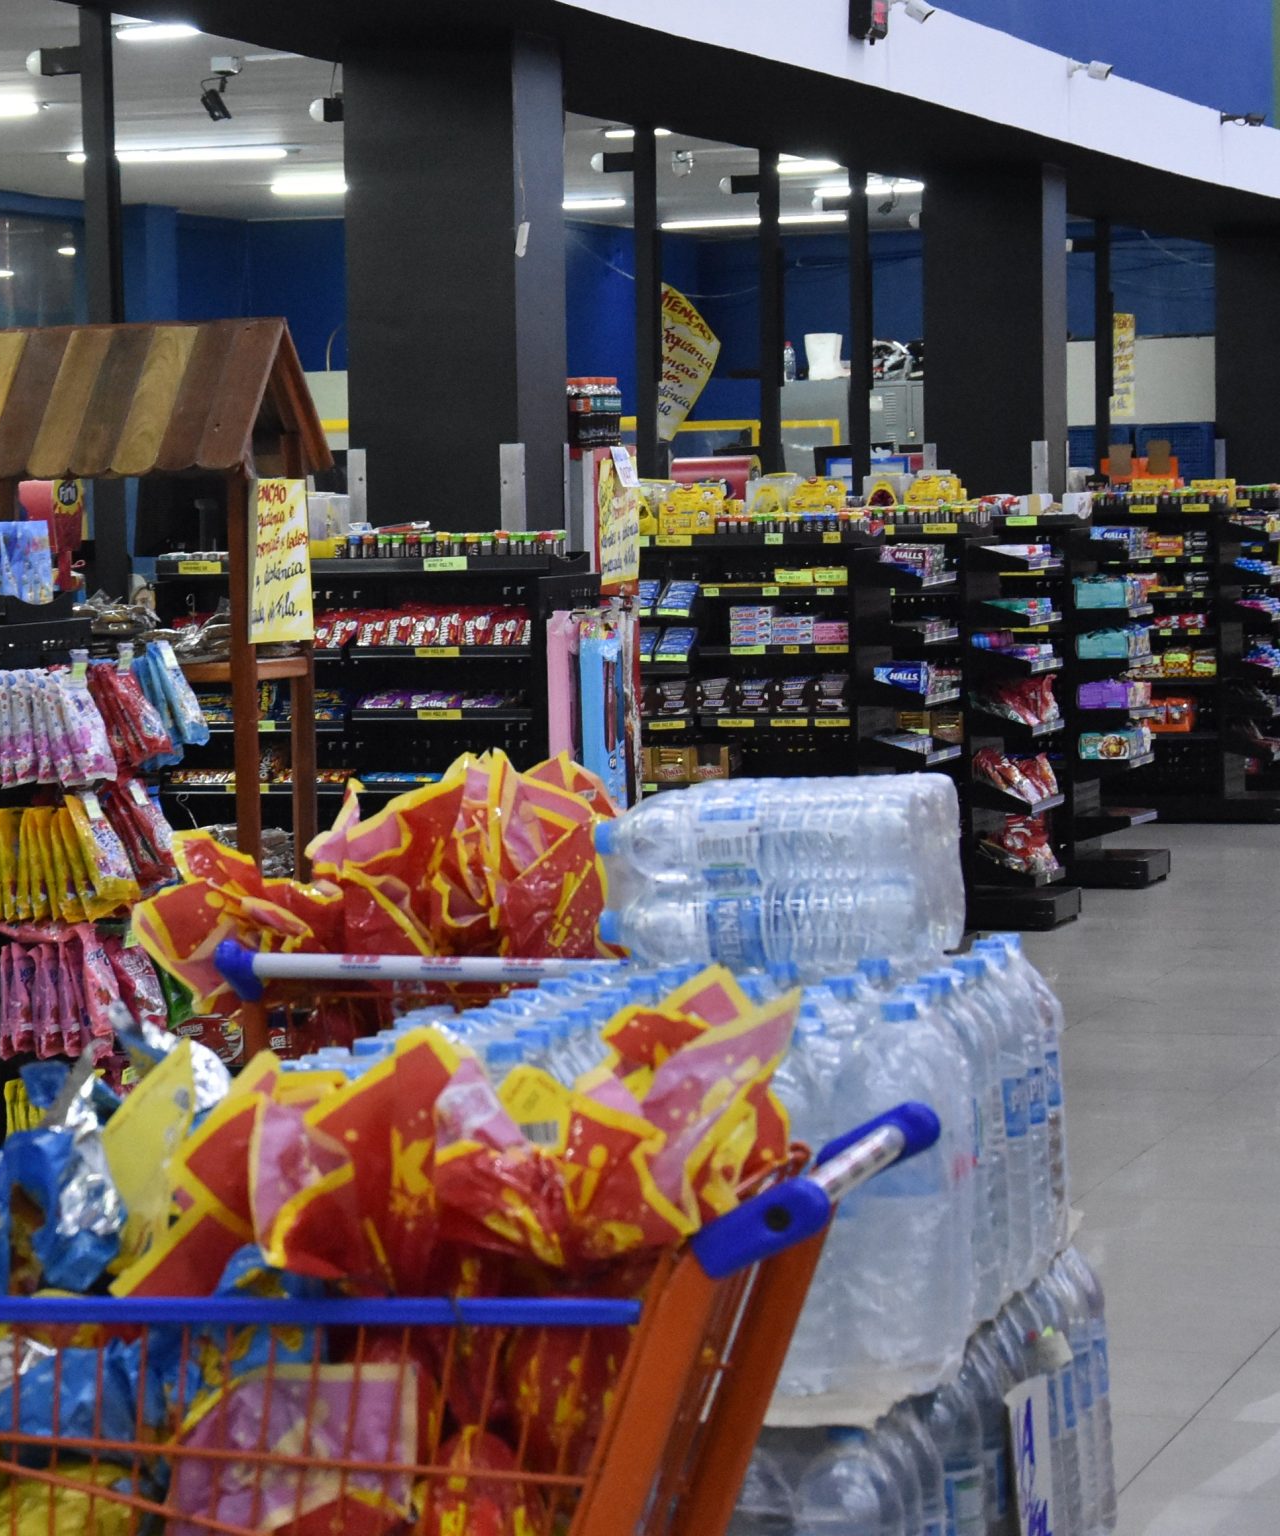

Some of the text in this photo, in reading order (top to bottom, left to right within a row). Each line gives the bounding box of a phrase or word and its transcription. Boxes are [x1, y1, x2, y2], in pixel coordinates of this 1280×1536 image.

[258, 483, 287, 504] ENÇÃO
[895, 551, 924, 560] HALLS
[889, 673, 919, 682] HALLS
